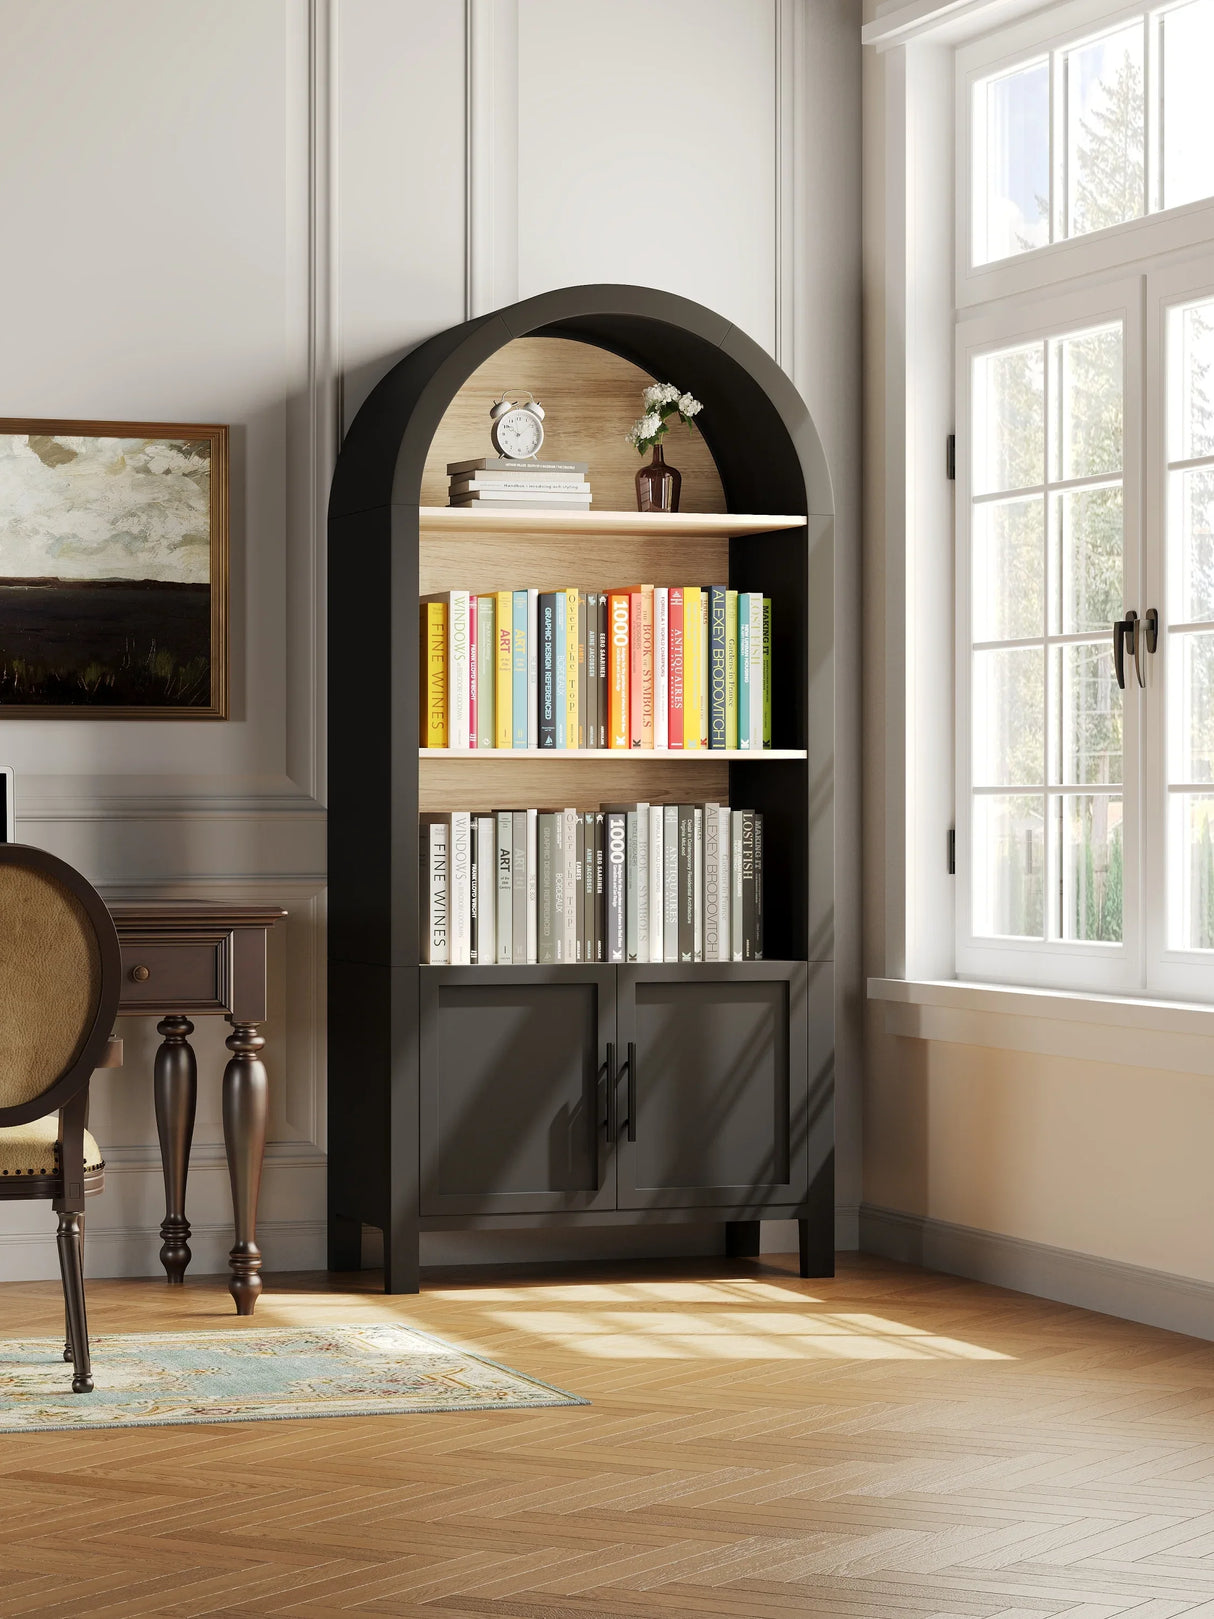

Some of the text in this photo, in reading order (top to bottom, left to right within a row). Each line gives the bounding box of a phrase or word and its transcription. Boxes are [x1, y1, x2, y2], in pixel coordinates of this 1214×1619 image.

[432, 624, 444, 662] FINE
[454, 596, 466, 660] WINDOWS
[500, 629, 510, 654] ART
[515, 629, 526, 654] ART
[613, 600, 628, 646] 1000
[642, 624, 652, 656] BOOK
[751, 598, 760, 665] LOST FISH
[673, 628, 682, 709] ANTIQUAIRES
[713, 590, 724, 740] ALEXEY BRODOVITCH
[763, 645, 769, 656] IT
[432, 671, 444, 729] WINES
[642, 670, 652, 728] SYMBOLS
[434, 844, 446, 881] FINE
[456, 818, 467, 880] WINDOWS
[500, 848, 510, 872] ART
[514, 848, 526, 872] ART
[610, 819, 625, 864] 1000
[743, 814, 753, 879] LOST FISH
[755, 859, 761, 870] IT
[668, 846, 677, 923] ANTIQUAIRES
[707, 807, 718, 952] ALEXEY BRODOVITCH
[434, 890, 446, 946] WINES
